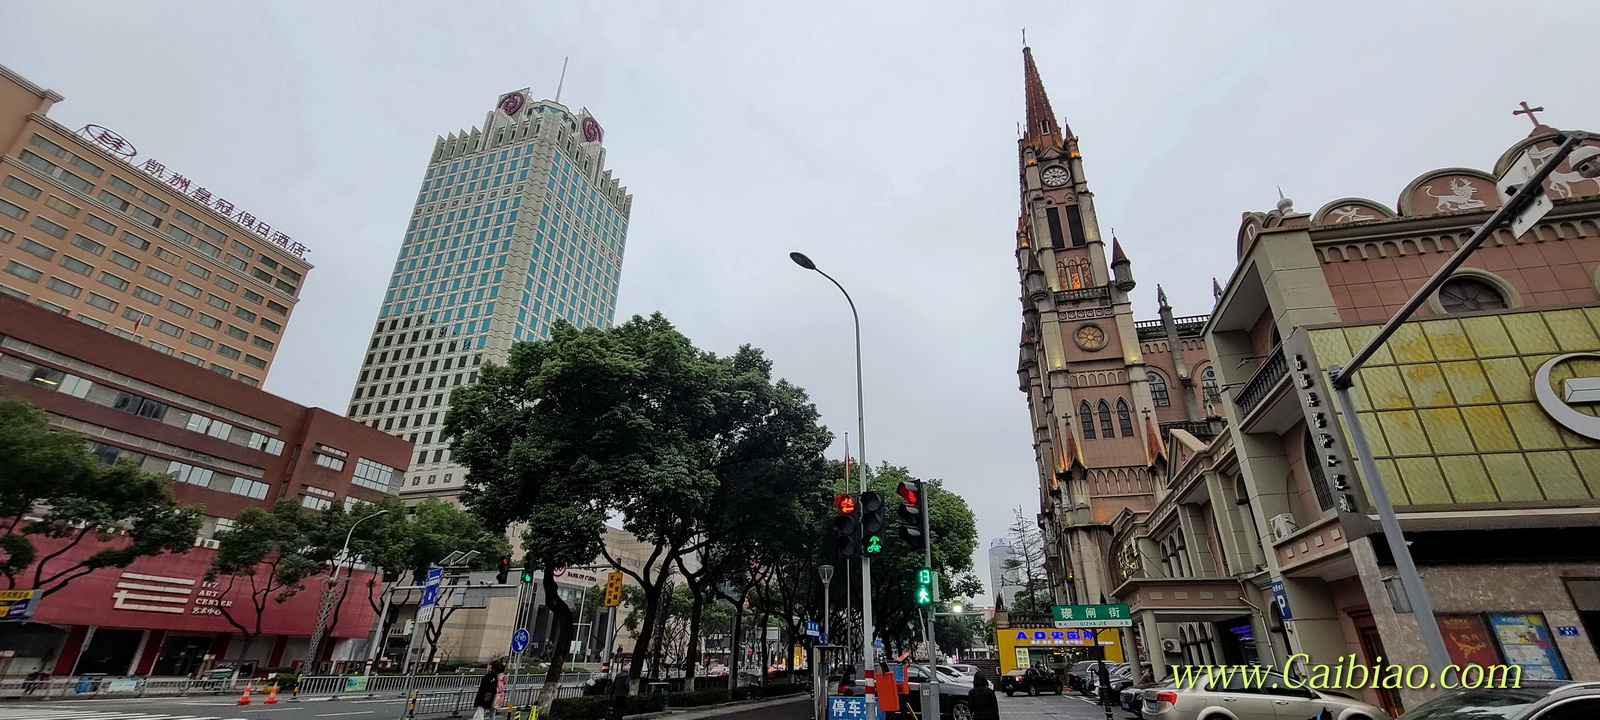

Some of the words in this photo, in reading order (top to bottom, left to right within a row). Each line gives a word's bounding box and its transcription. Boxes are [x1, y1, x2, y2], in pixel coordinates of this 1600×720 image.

[144, 158, 305, 258] 凯洲皇冠假日酒店
[920, 570, 930, 584] 13
[195, 598, 233, 607] CENTER
[1277, 594, 1286, 616] P
[192, 606, 222, 616] 艺术中心
